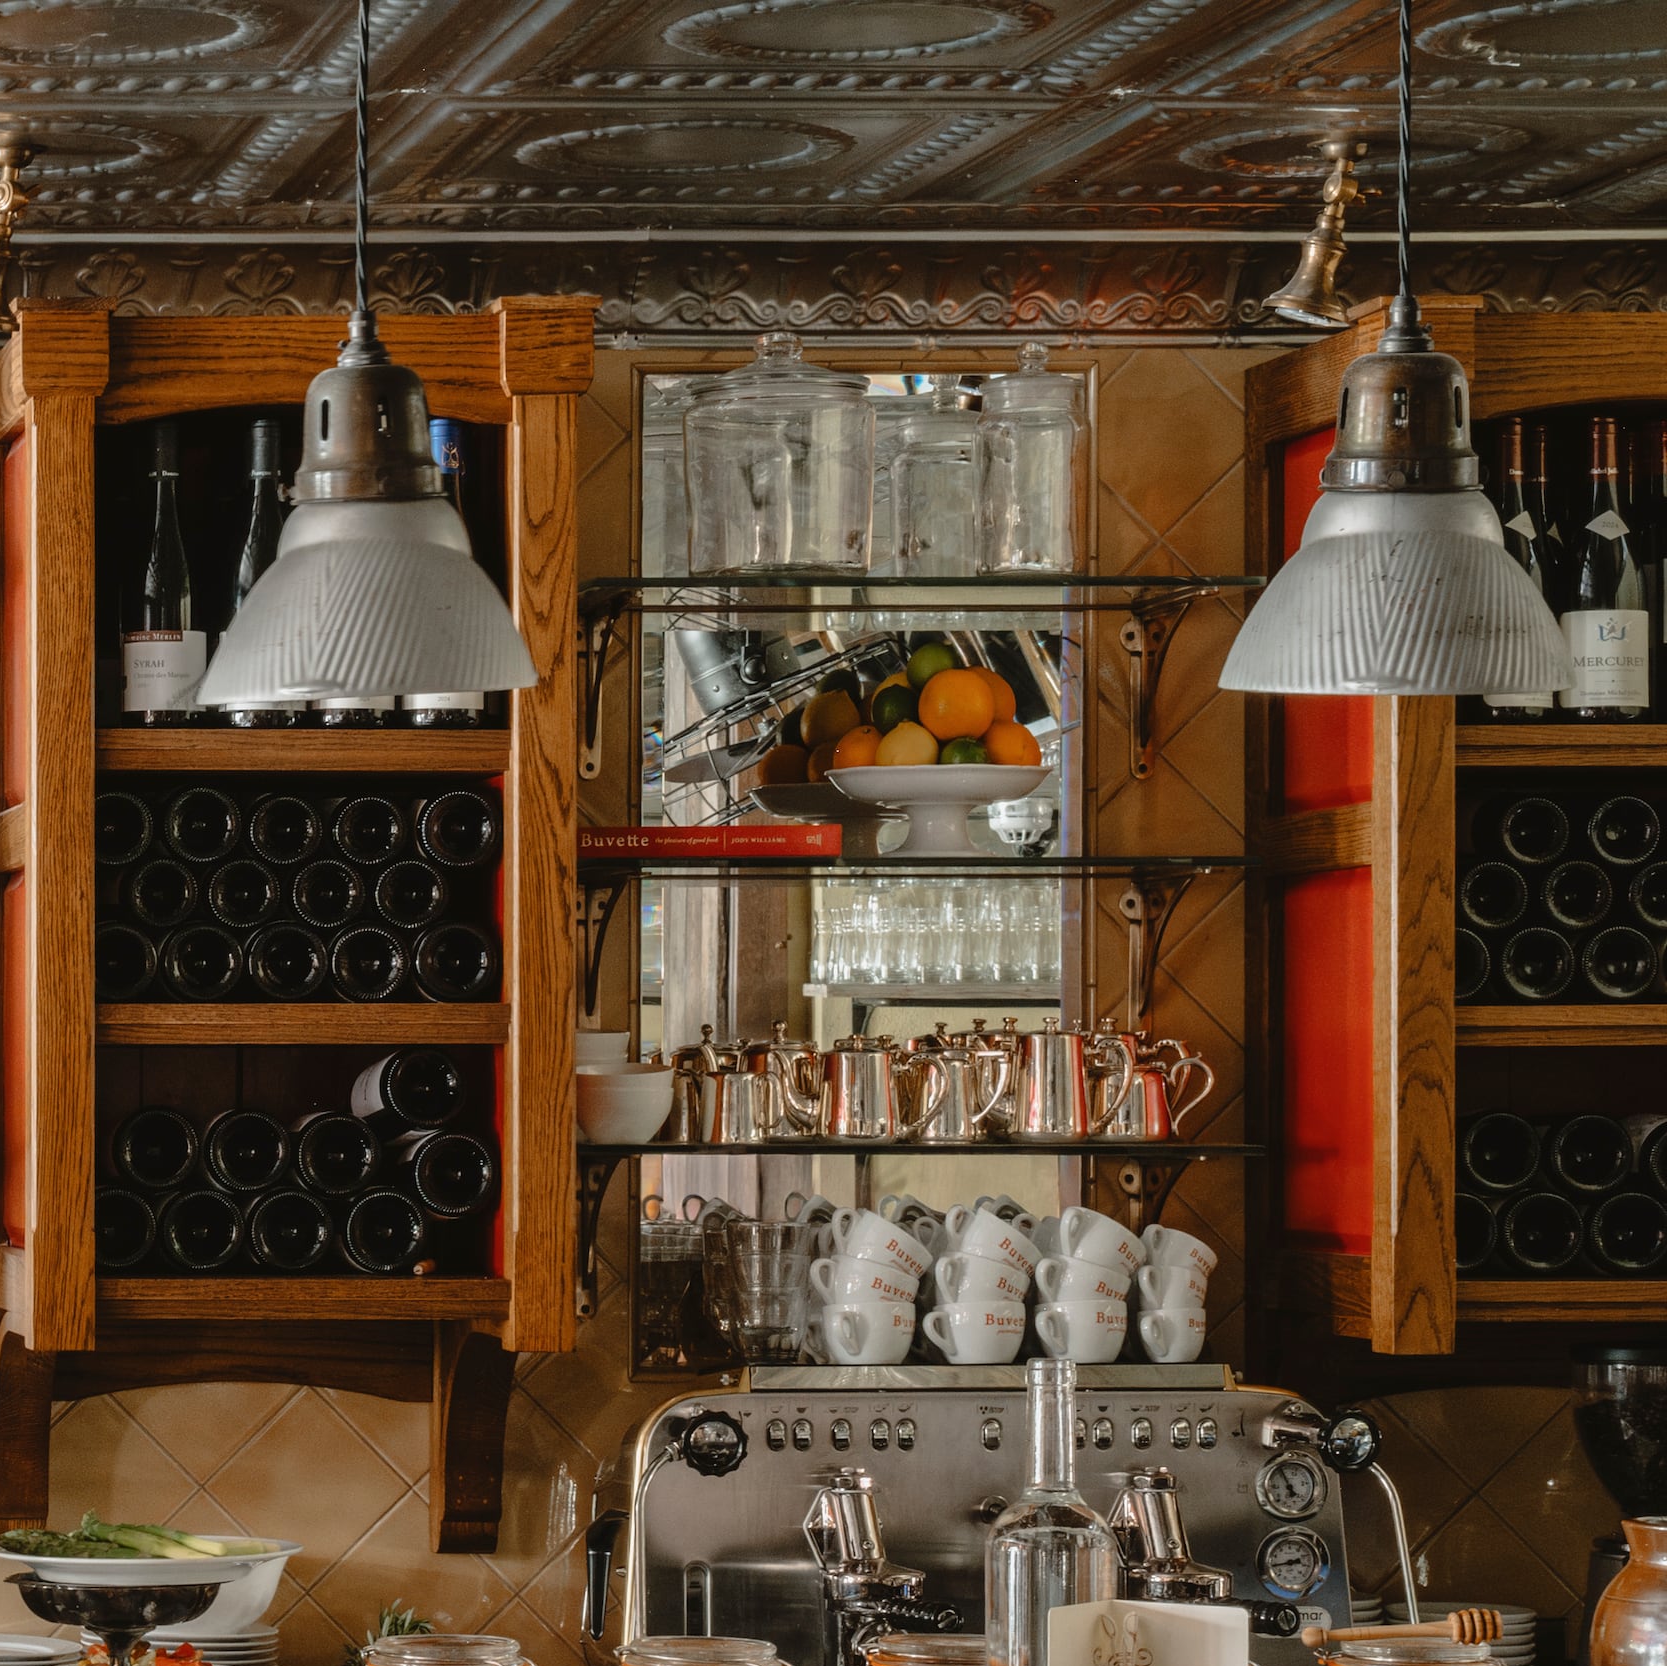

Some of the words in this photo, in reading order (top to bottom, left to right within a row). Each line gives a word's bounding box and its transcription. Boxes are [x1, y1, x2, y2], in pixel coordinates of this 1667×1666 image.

[133, 660, 164, 668] SYRAH
[580, 833, 649, 847] Buvette
[1299, 1611, 1324, 1620] mar
